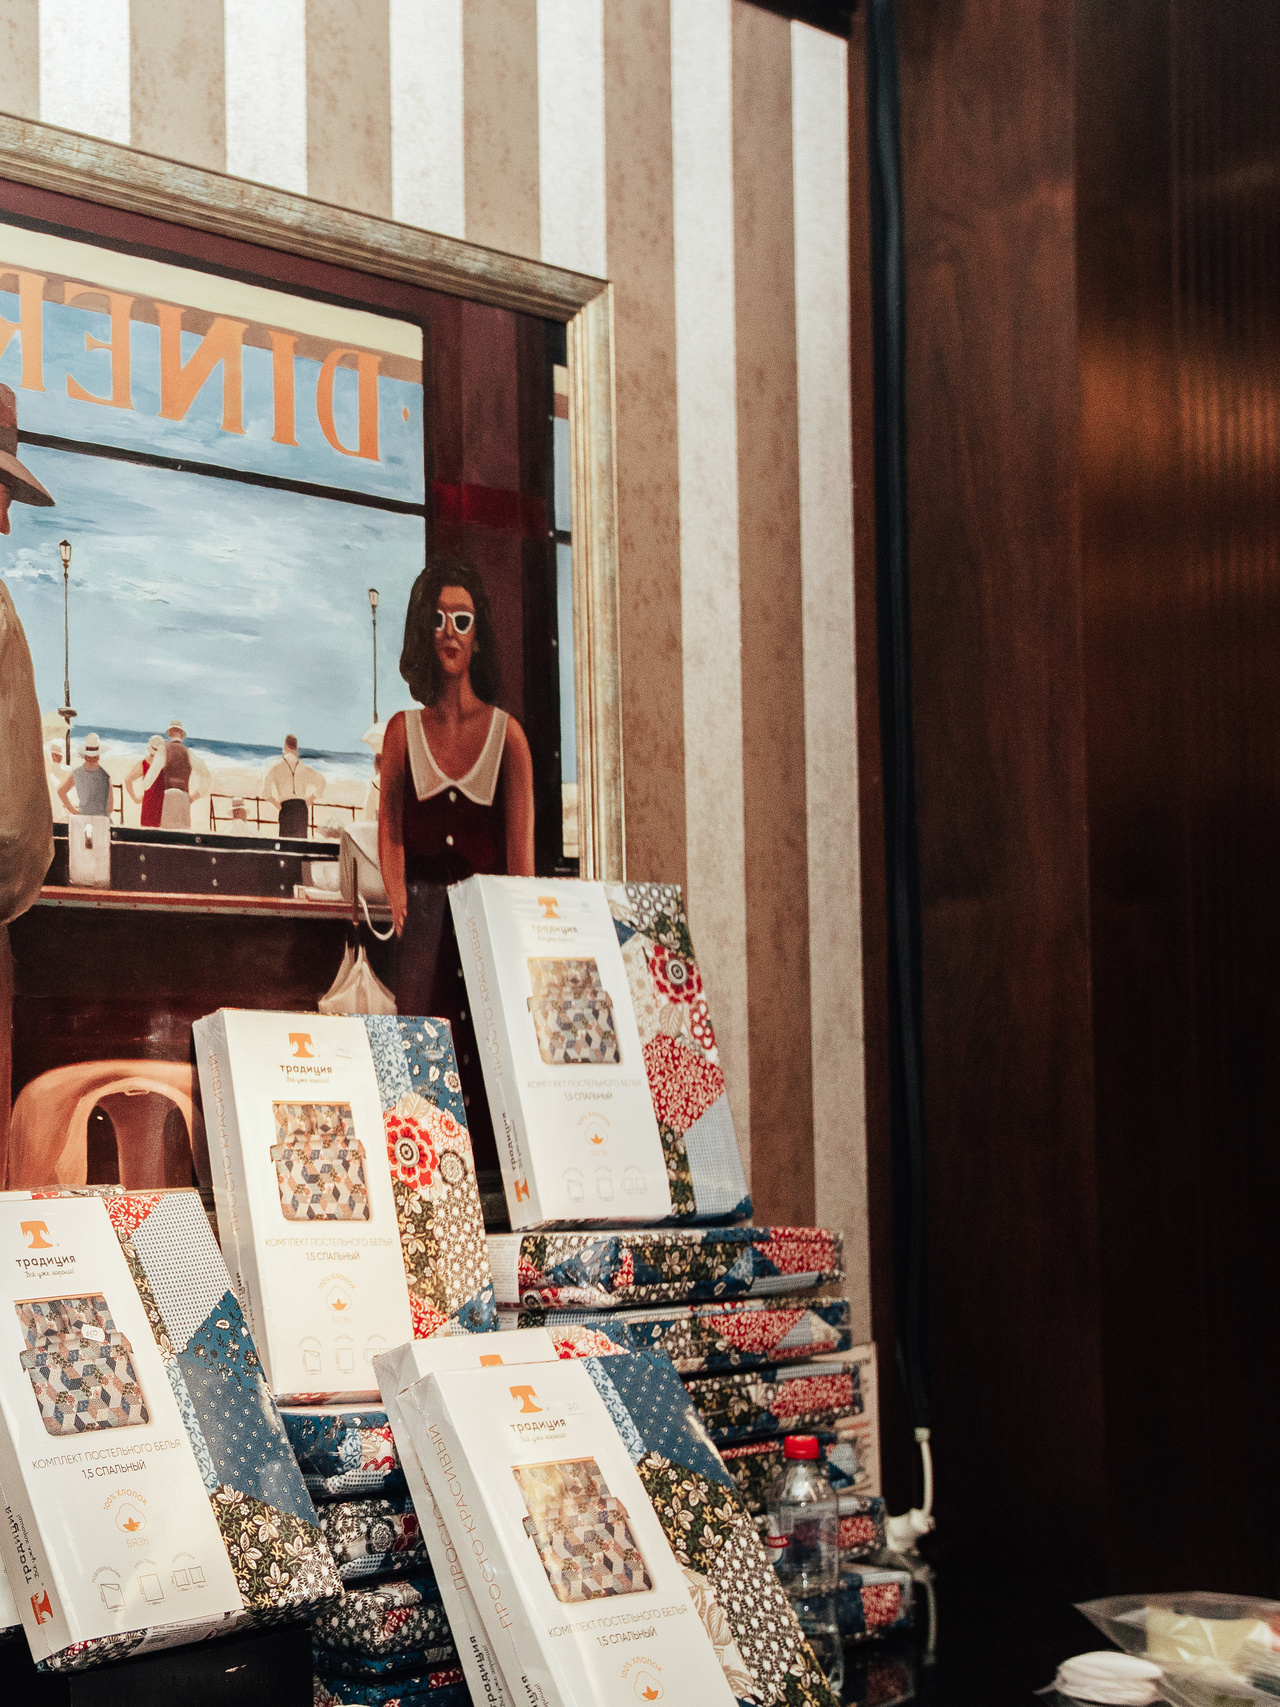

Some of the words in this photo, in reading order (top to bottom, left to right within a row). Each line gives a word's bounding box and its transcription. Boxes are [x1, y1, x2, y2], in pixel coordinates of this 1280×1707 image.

[279, 1064, 333, 1076] традиция
[15, 1255, 77, 1270] традиция
[509, 1418, 567, 1435] традиция
[32, 1453, 83, 1470] КОМПЛЕКТ
[85, 1442, 153, 1462] ПОСТЕЛЬНОГО
[154, 1438, 182, 1452] БЕЛЬЯ
[81, 1468, 95, 1480] 1,5
[95, 1459, 147, 1478] СПАЛЬНЫЙ
[426, 1423, 477, 1534] КРАСИВЫЙ
[103, 1494, 117, 1511] 100%
[116, 1488, 148, 1506] ХЛОПОК
[4, 1506, 33, 1584] традиция
[125, 1537, 149, 1549] БЯЗЬ
[472, 1539, 513, 1630] ПРОСТО
[547, 1620, 596, 1638] КОМПЛЕКТ
[597, 1609, 661, 1629] ПОСТЕЛЬНОГО
[662, 1604, 689, 1618] БЕЛЬЯ
[596, 1636, 609, 1648] 1,5
[609, 1626, 658, 1645] СПАЛЬНЫЙ
[631, 1656, 663, 1673] ХЛОПОК
